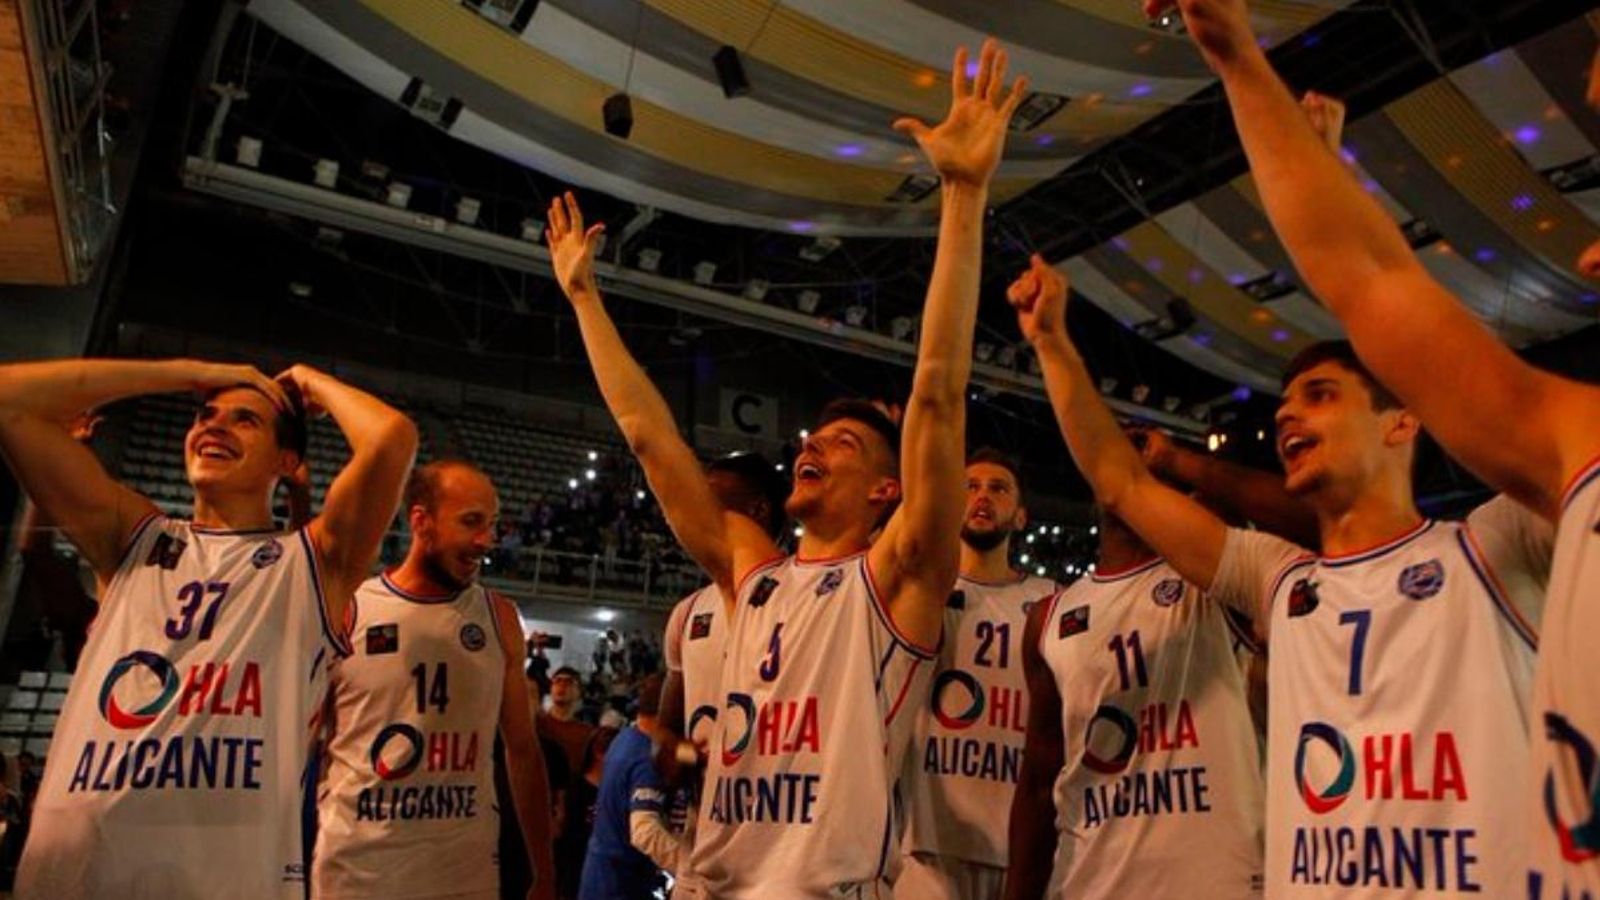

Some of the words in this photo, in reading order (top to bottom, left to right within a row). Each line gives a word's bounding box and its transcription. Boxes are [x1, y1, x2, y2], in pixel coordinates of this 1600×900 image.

[732, 394, 763, 434] C
[164, 580, 230, 641] 37
[973, 620, 1011, 669] 21
[1107, 629, 1149, 691] 11
[1338, 608, 1372, 696] 7
[410, 662, 450, 715] 14
[988, 685, 1025, 733] HL
[68, 735, 264, 793] ALICANTE
[924, 736, 1020, 784] ALICAN
[356, 784, 478, 821] ALICANTE
[708, 773, 820, 825] AICNTE
[1083, 766, 1211, 829] AICANTE
[1291, 826, 1482, 892] ALICANTE
